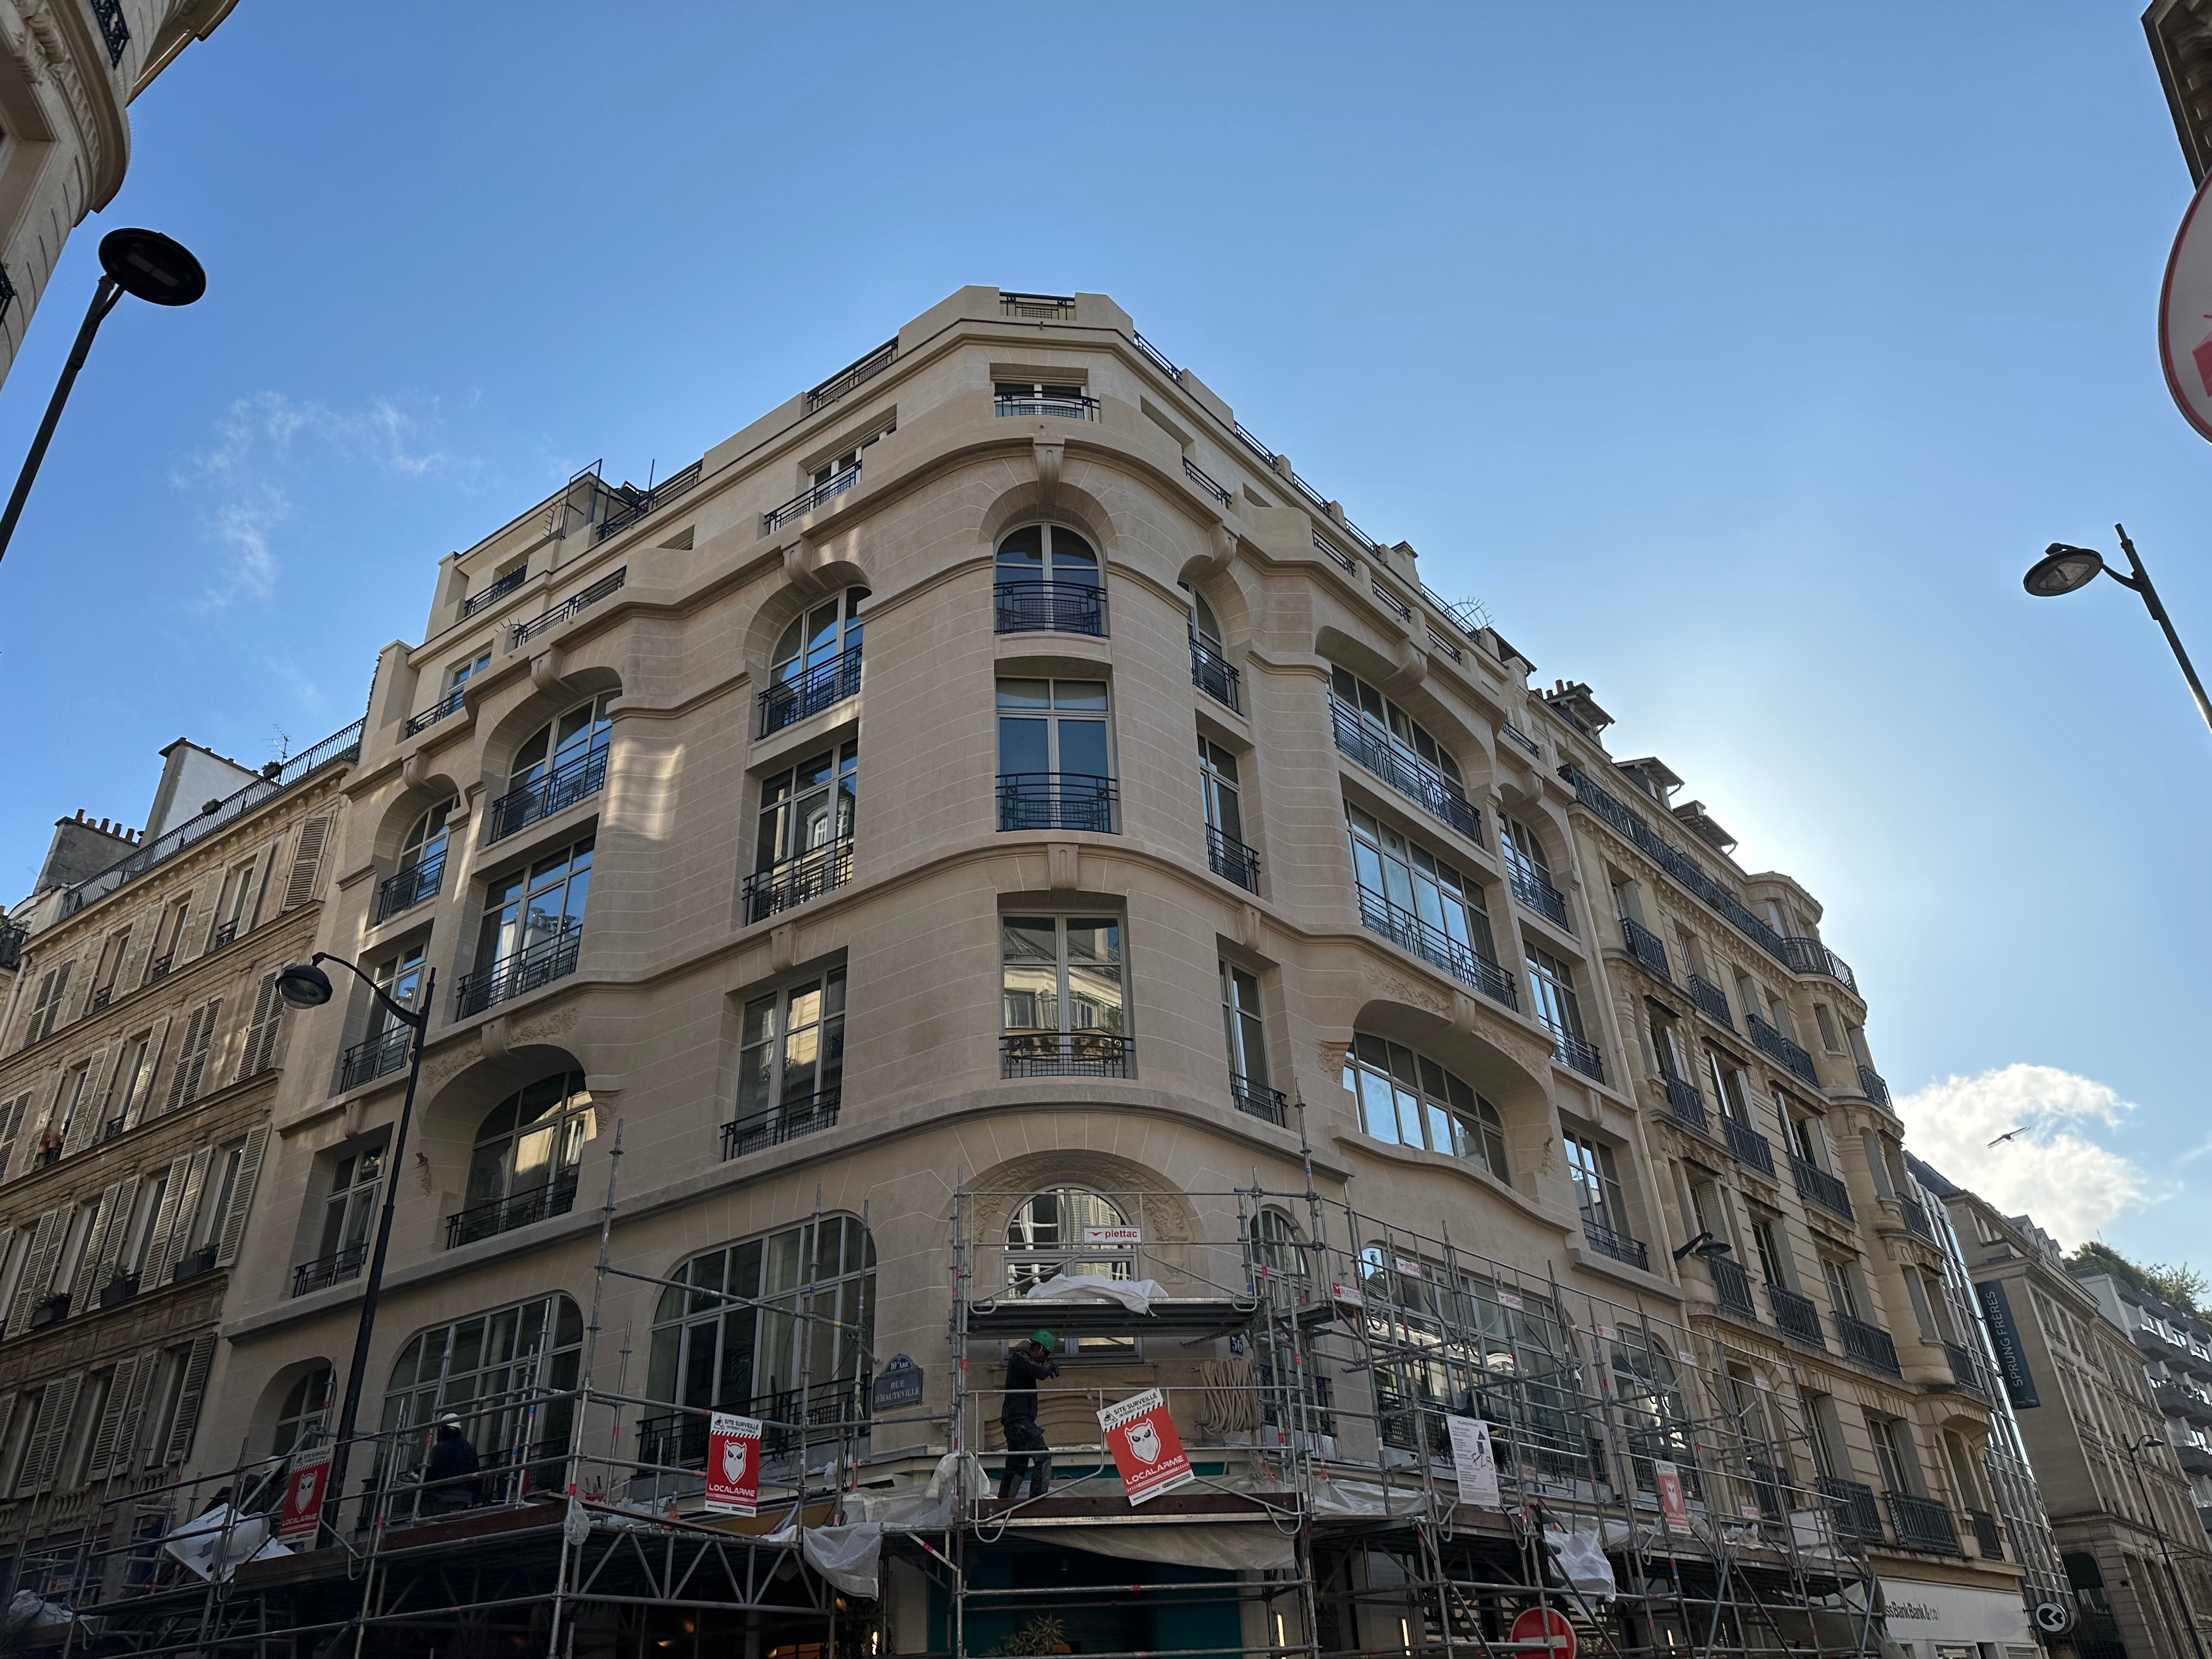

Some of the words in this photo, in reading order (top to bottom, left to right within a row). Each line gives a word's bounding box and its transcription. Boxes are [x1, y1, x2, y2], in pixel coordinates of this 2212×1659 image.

[1105, 1229, 1137, 1239] plettac
[1985, 1290, 2007, 1335] FRÈRES
[1232, 1336, 1243, 1352] 36
[2000, 1338, 2023, 1387] SPRUNG
[890, 1379, 905, 1390] RUE
[875, 1387, 919, 1403] D'HAUTEVILLE
[1113, 1406, 1126, 1415] SITE
[1127, 1392, 1158, 1409] SURVEILLÉ
[735, 1420, 759, 1430] SURVEILLÉ
[1125, 1455, 1184, 1485] LOCALARME
[709, 1483, 755, 1497] LOCALARME
[282, 1513, 318, 1526] LOCALARME
